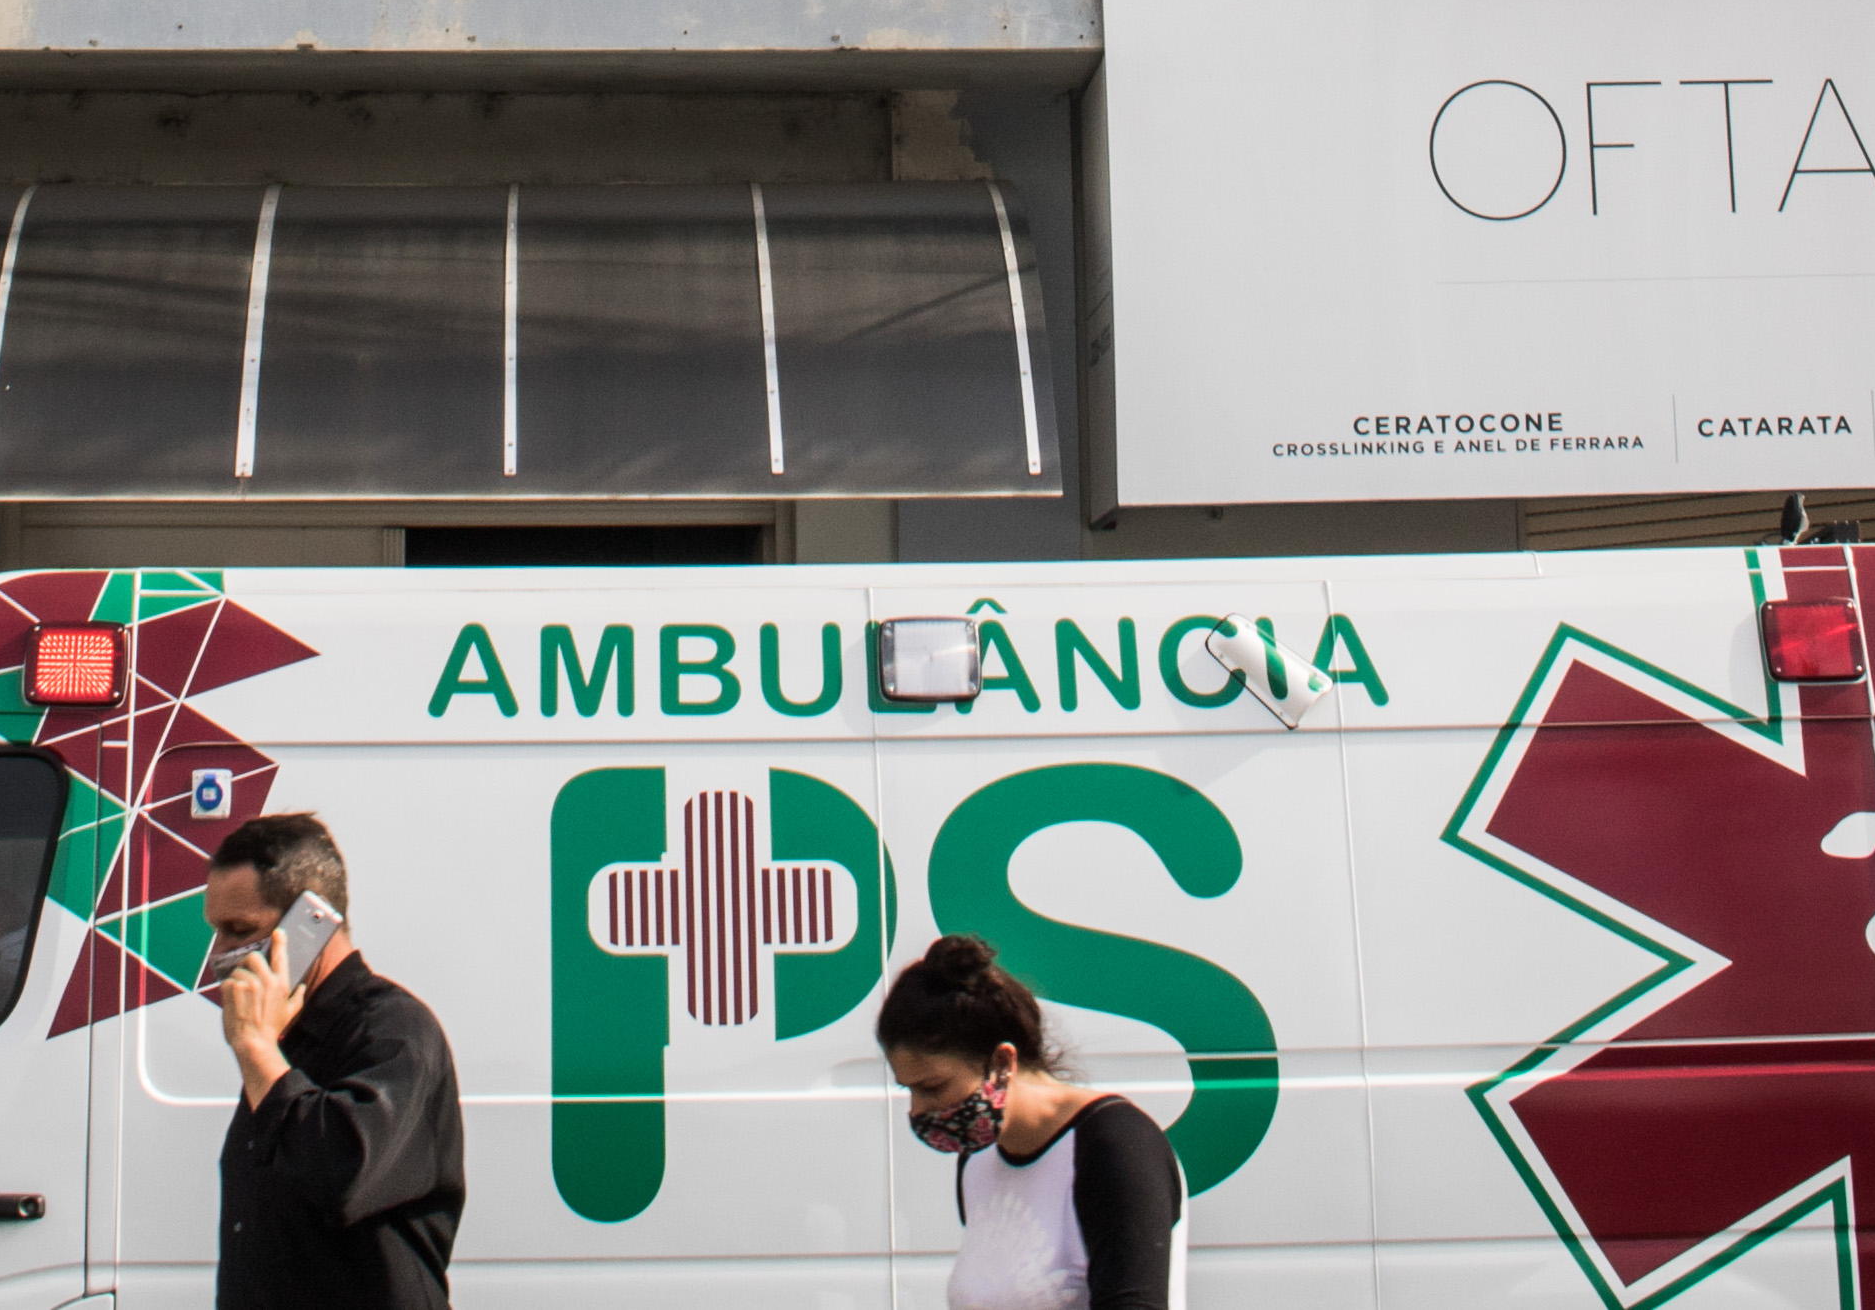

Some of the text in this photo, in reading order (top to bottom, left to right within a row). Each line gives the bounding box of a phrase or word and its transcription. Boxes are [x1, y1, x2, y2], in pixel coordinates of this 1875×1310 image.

[1353, 412, 1563, 436] CERATOCONE
[1697, 415, 1853, 438] CATARATA
[1272, 435, 1645, 457] CROSSLINKING E ANEL DE FERRARA
[428, 597, 1389, 718] AMBULÂNCIA
[550, 762, 1280, 1224] PS
